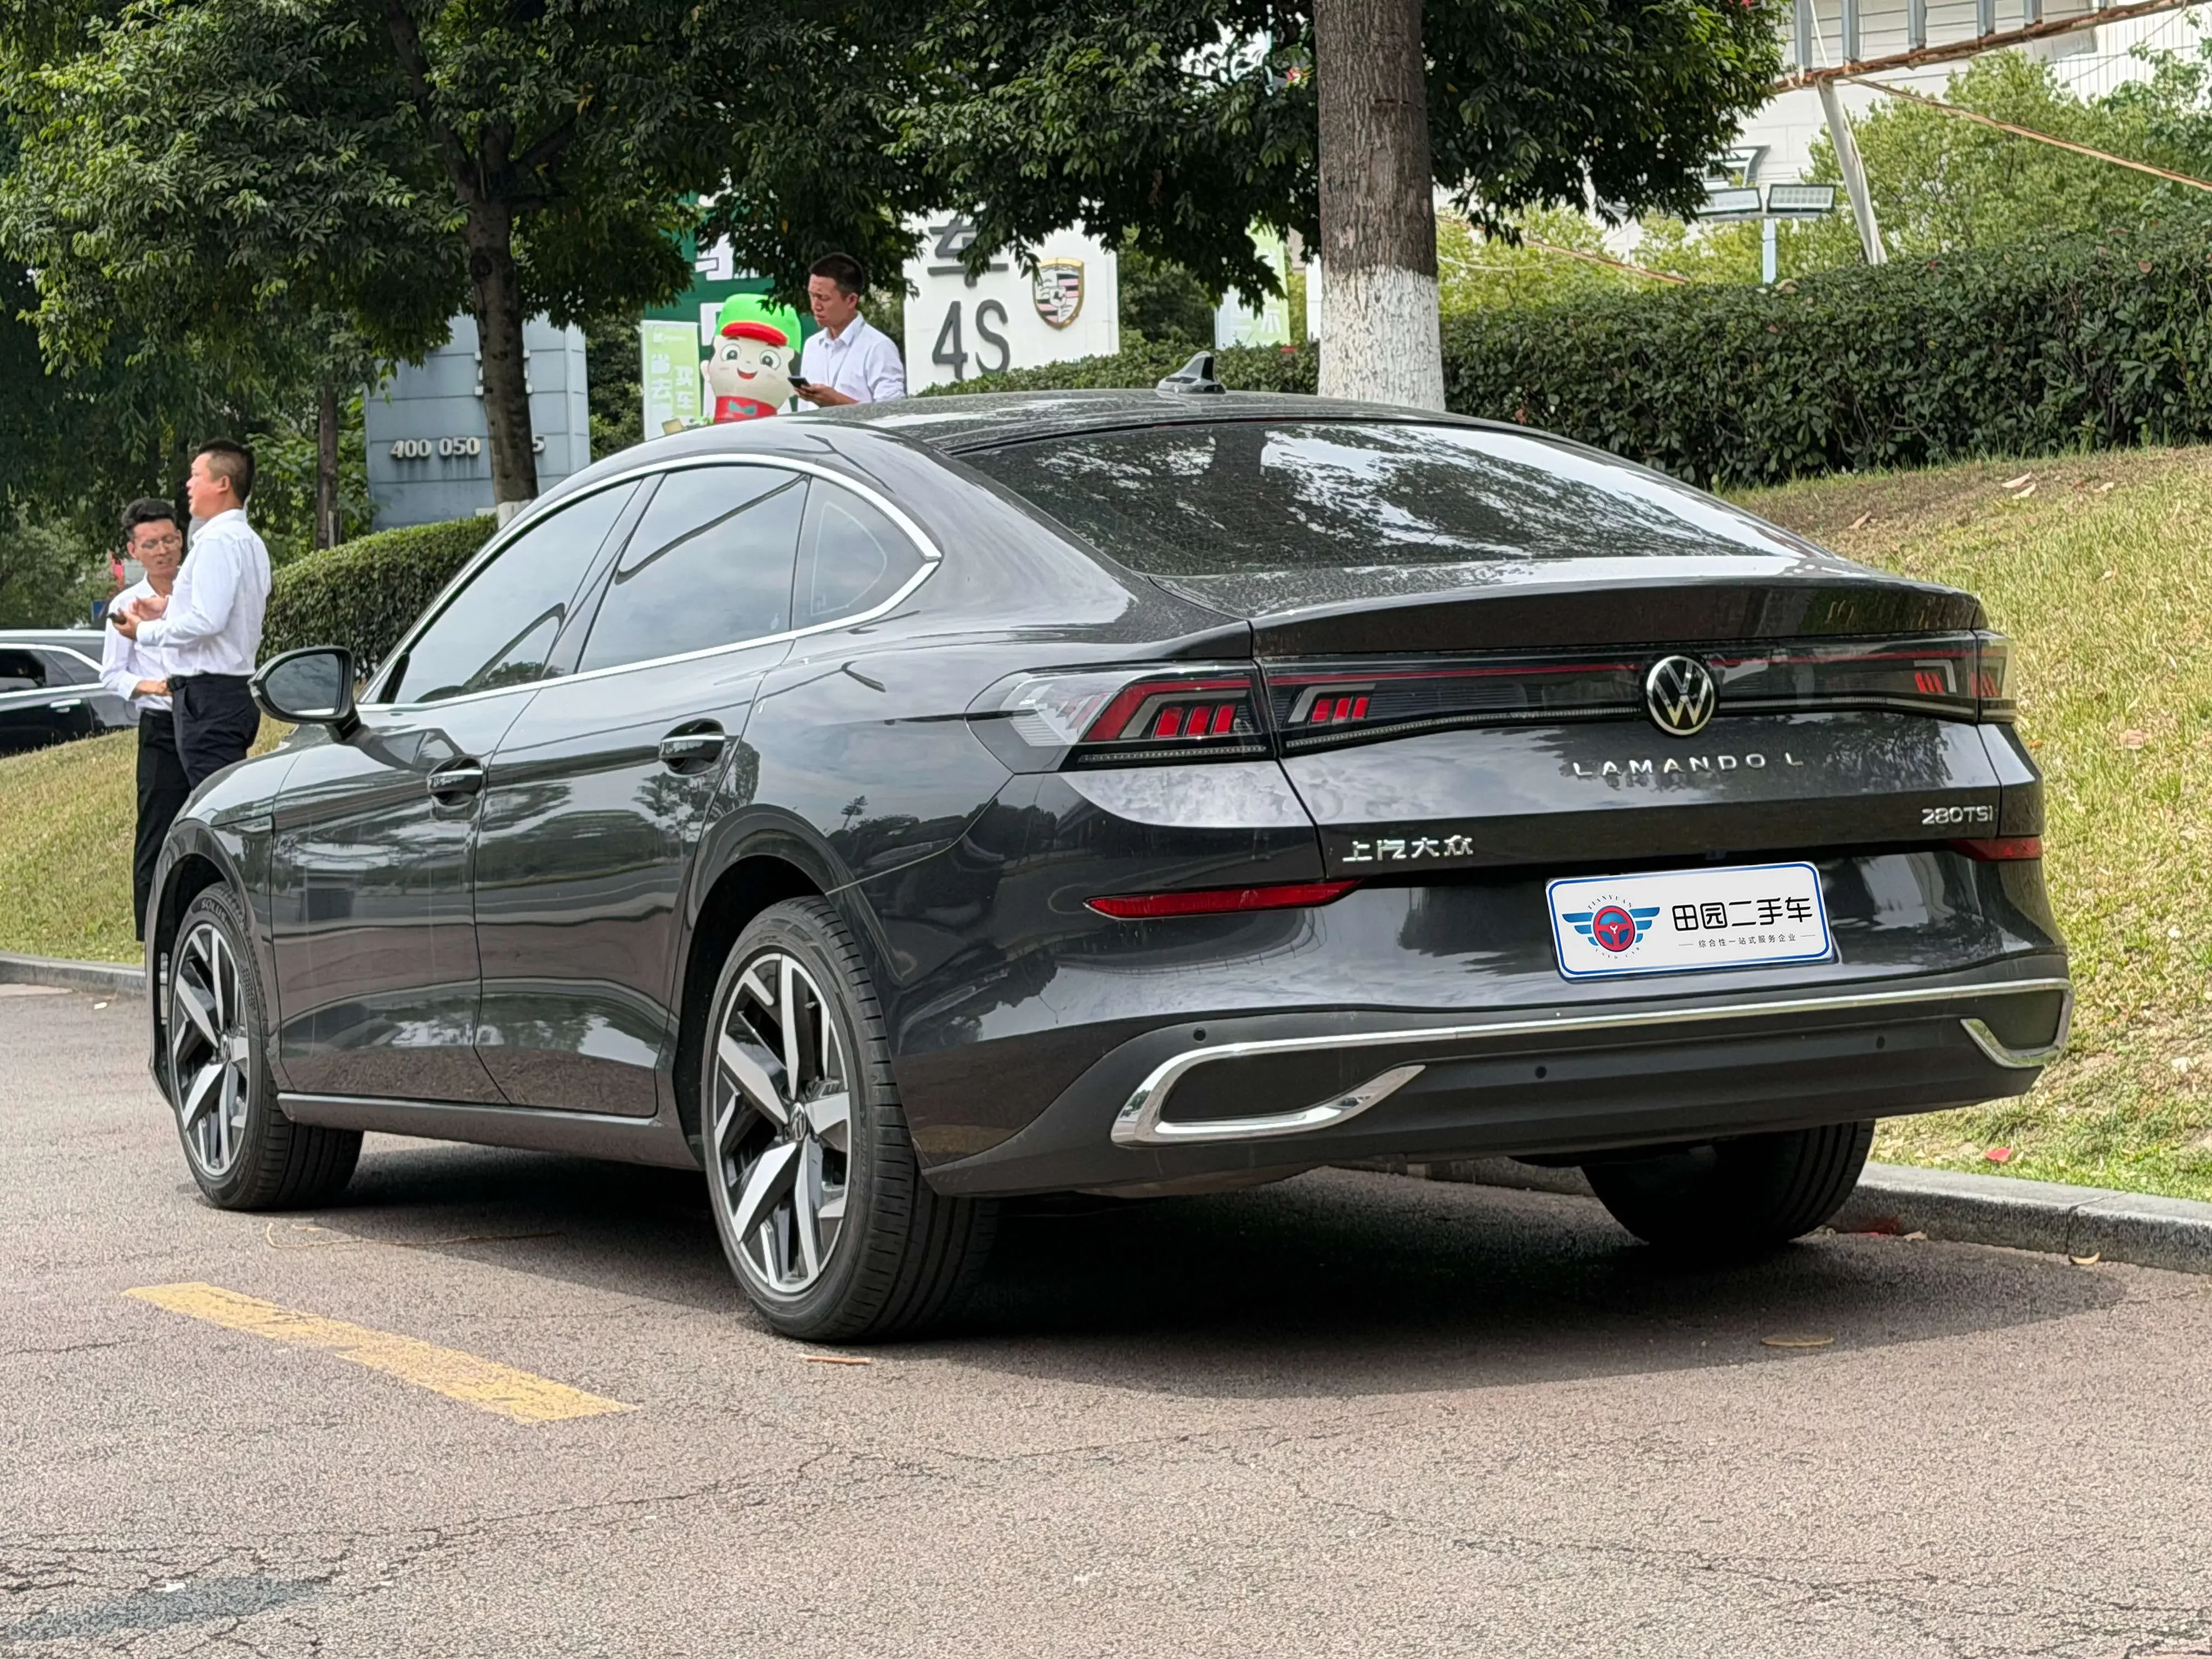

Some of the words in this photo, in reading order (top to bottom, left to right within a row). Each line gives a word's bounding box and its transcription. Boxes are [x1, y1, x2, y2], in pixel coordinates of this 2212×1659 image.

[933, 300, 1011, 380] 4S
[390, 439, 432, 458] 400
[439, 437, 481, 456] 050
[1573, 754, 1765, 776] LAMANDO
[1785, 752, 1804, 766] L
[1342, 834, 1474, 862] 上汽大众
[1672, 896, 1813, 932] 田园二手车
[1698, 933, 1797, 948] 综合性一站式服务企业
